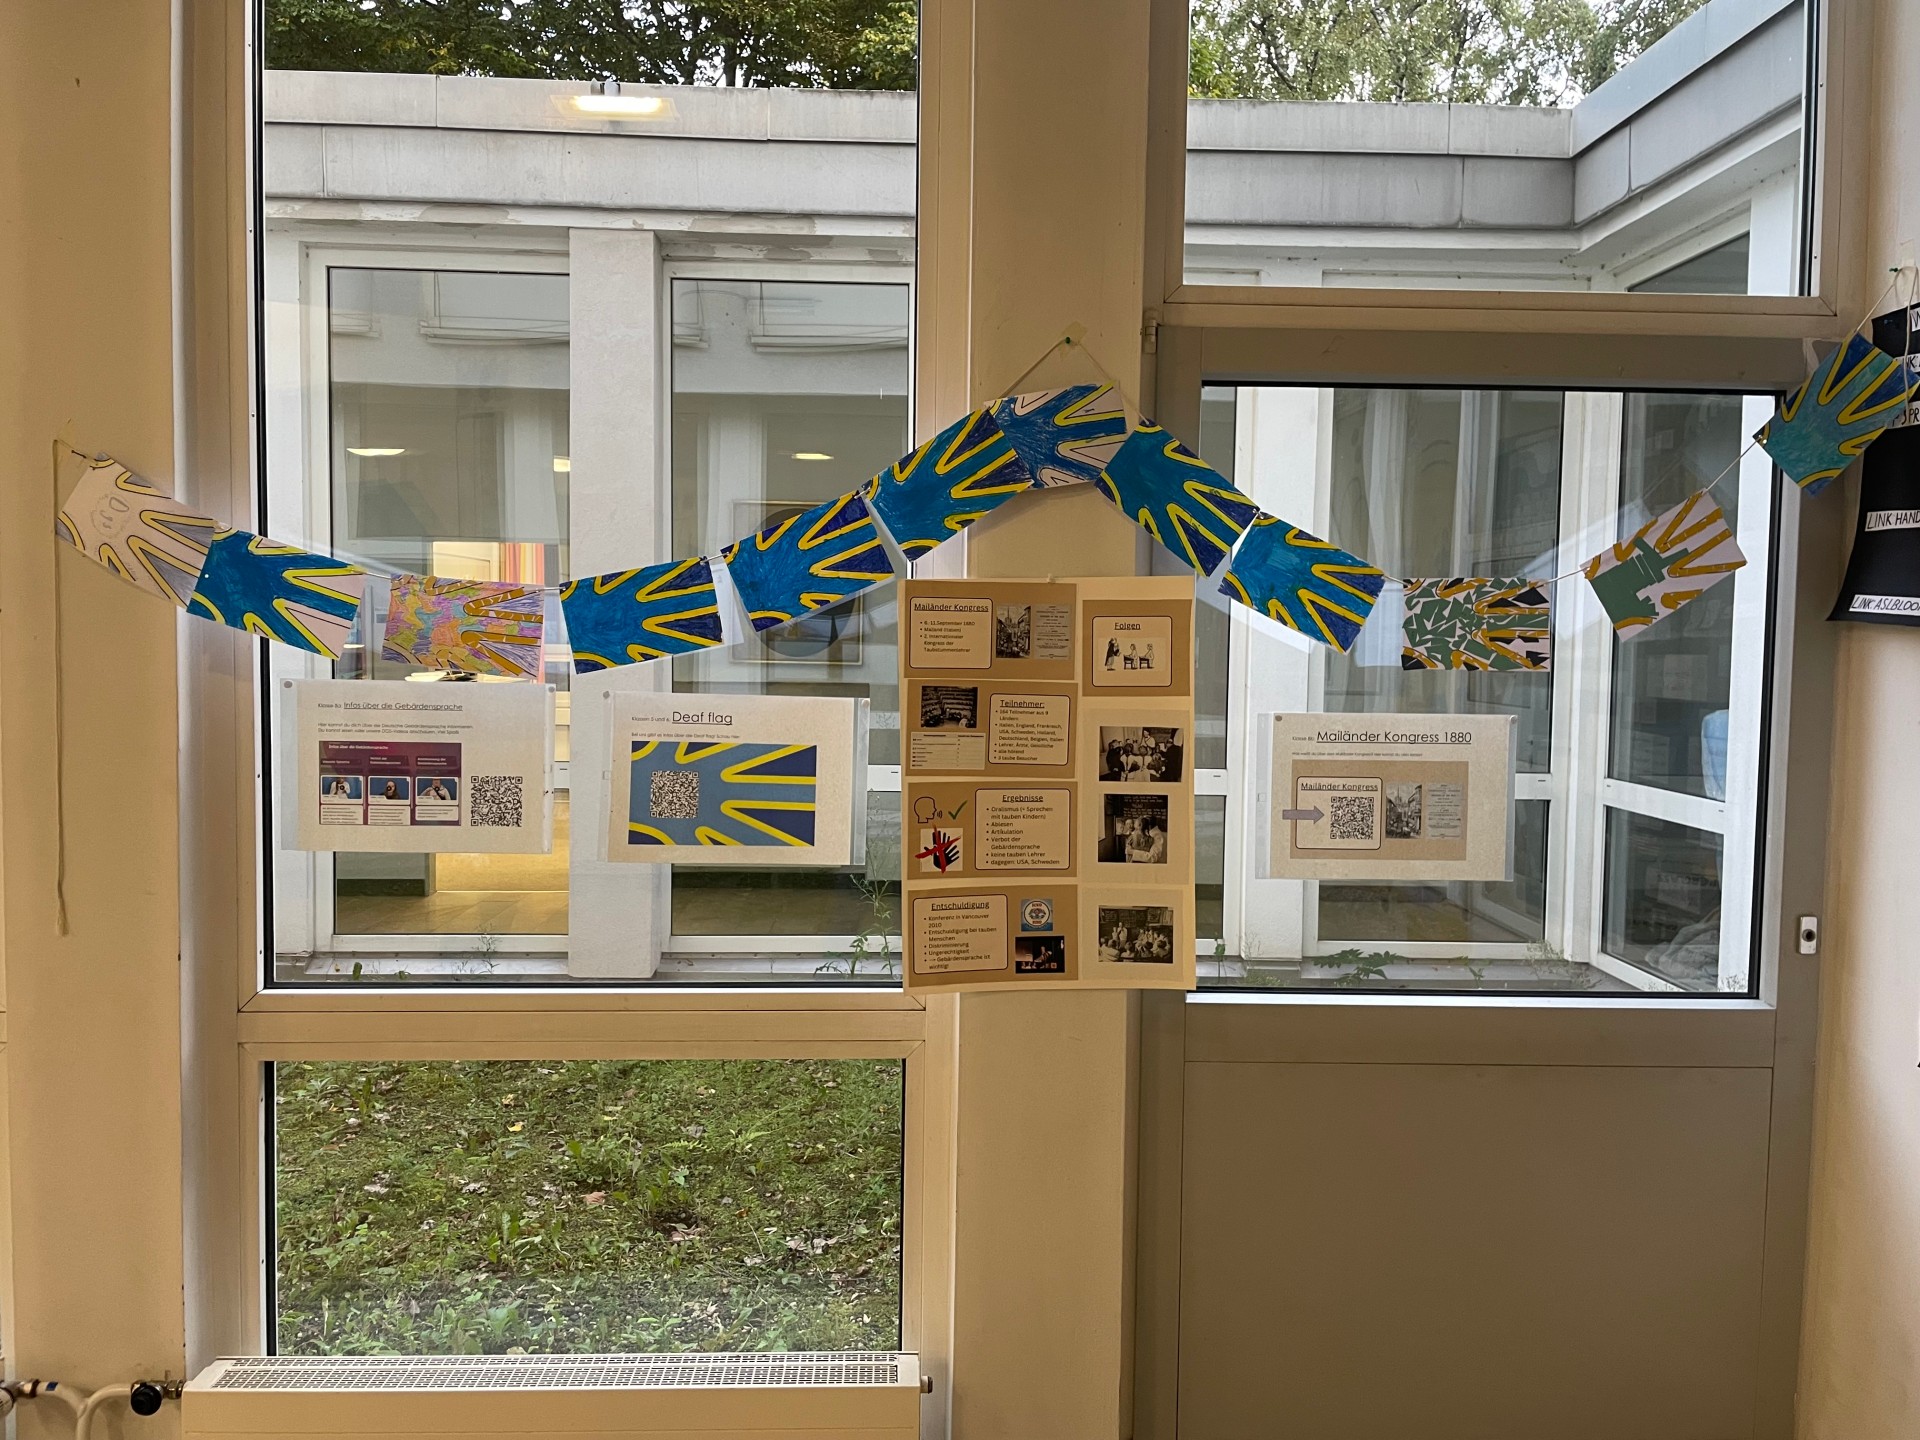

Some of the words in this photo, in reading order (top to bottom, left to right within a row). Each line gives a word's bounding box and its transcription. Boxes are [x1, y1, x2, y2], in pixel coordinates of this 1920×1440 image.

[914, 602, 952, 612] Mailänder
[954, 603, 988, 612] Kongress
[1875, 598, 1920, 611] ASLBLOO
[1114, 622, 1141, 631] Folgen
[344, 702, 361, 710] Infos
[362, 702, 379, 710] über
[394, 702, 462, 712] Gebärdensprache
[1000, 700, 1044, 708] Teilnehmer:
[672, 711, 704, 724] Deaf
[708, 712, 732, 726] flag
[1316, 730, 1381, 744] Mailänder
[1384, 732, 1439, 744] Kongress
[1444, 732, 1472, 744] 1880
[1301, 782, 1340, 792] Mailänder
[1342, 782, 1378, 792] Kongress
[1002, 794, 1043, 803] Ergebnisse
[931, 901, 990, 912] Entschuldigung
